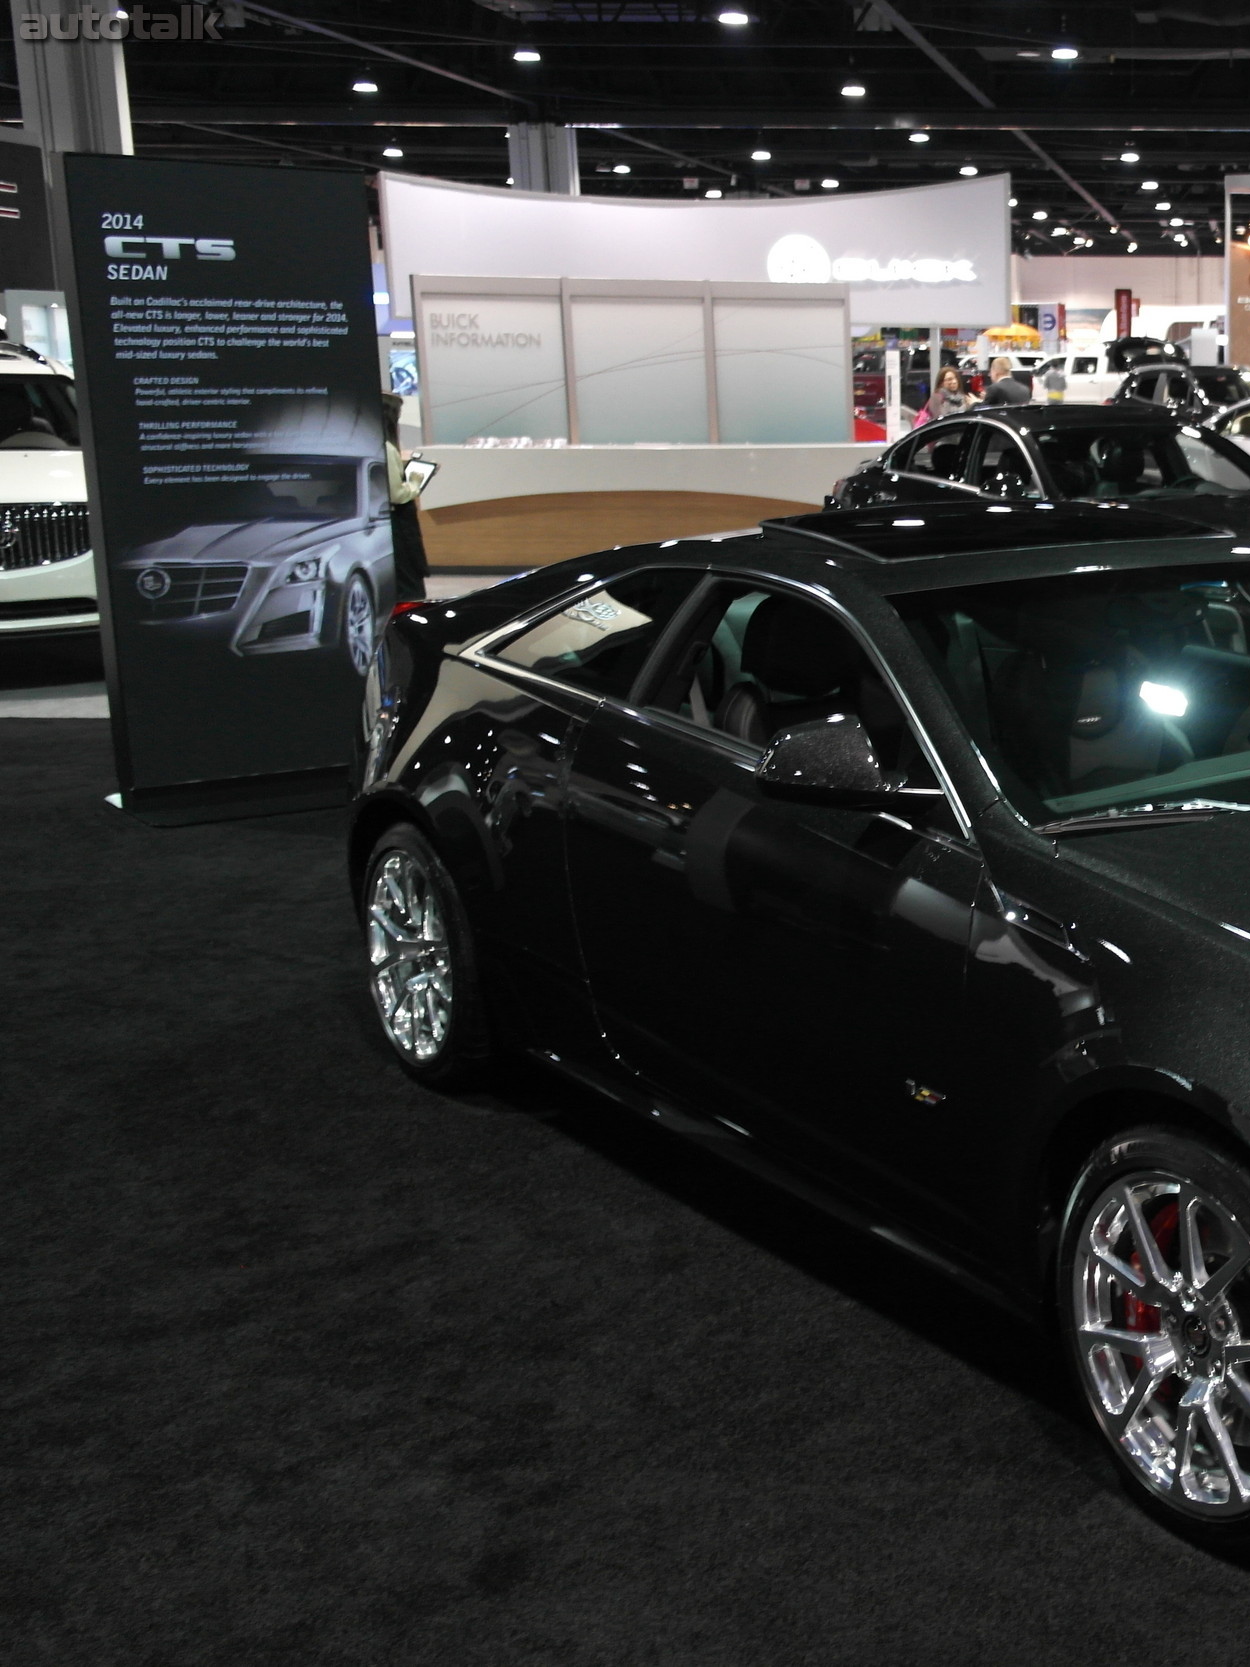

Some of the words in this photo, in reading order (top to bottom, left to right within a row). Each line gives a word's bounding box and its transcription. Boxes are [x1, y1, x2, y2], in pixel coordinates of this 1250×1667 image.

[101, 213, 144, 230] 2014
[104, 236, 237, 261] CTS
[107, 264, 168, 281] SEDAN
[110, 296, 132, 306] Built
[133, 298, 145, 306] on
[146, 296, 188, 307] Cadillac's
[188, 298, 233, 308] acclaimed
[234, 299, 276, 309] rear-drive
[276, 300, 327, 311] architecture,
[329, 300, 344, 310] the
[111, 310, 144, 320] all-new
[145, 310, 163, 320] CTS
[164, 311, 172, 320] is
[174, 311, 202, 322] longer,
[204, 311, 230, 322] lower,
[232, 312, 259, 321] leaner
[260, 312, 277, 321] and
[277, 313, 311, 323] stronger
[311, 312, 325, 324] for
[429, 313, 480, 329] BUICK
[113, 323, 152, 333] Elevated
[153, 324, 182, 335] luxury,
[184, 324, 225, 334] enhanced
[226, 324, 279, 335] performance
[279, 325, 296, 335] and
[296, 326, 349, 336] sophisticated
[114, 337, 161, 348] technology
[162, 337, 197, 348] position
[197, 336, 215, 347] CTS
[216, 337, 226, 347] to
[226, 337, 267, 349] challenge
[267, 338, 282, 347] the
[282, 338, 311, 348] world's
[312, 338, 330, 348] best
[430, 331, 542, 348] INFORMATION
[115, 350, 158, 360] mid-sized
[159, 350, 186, 361] luxury
[187, 350, 219, 360] sedans.
[133, 376, 169, 385] CRAFTED
[170, 376, 200, 385] DESIGN
[139, 422, 180, 430] THRILLING
[181, 421, 238, 429] PERFORMANCE
[142, 464, 201, 474] SOPHISTICATED
[202, 463, 250, 473] TECHNOLOGY
